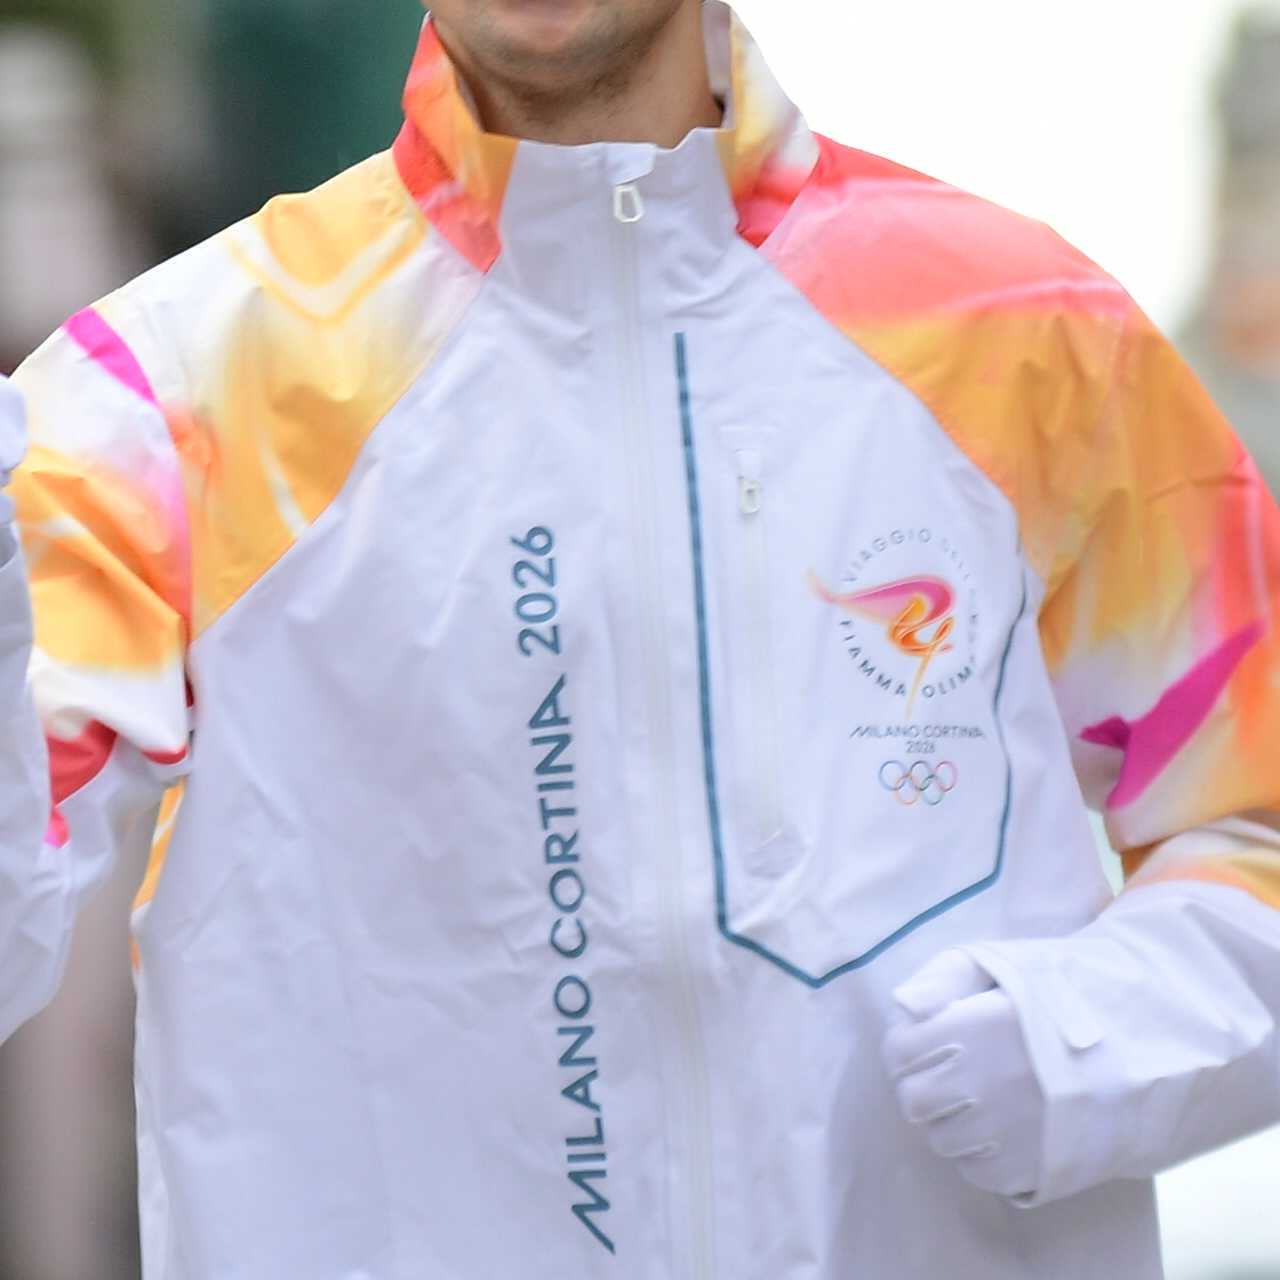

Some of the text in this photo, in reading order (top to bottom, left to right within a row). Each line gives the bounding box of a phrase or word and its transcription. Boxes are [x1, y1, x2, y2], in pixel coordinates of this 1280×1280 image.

[511, 524, 615, 1256] MILANO CORTINA 2026
[849, 724, 986, 739] MILANO CORTINA
